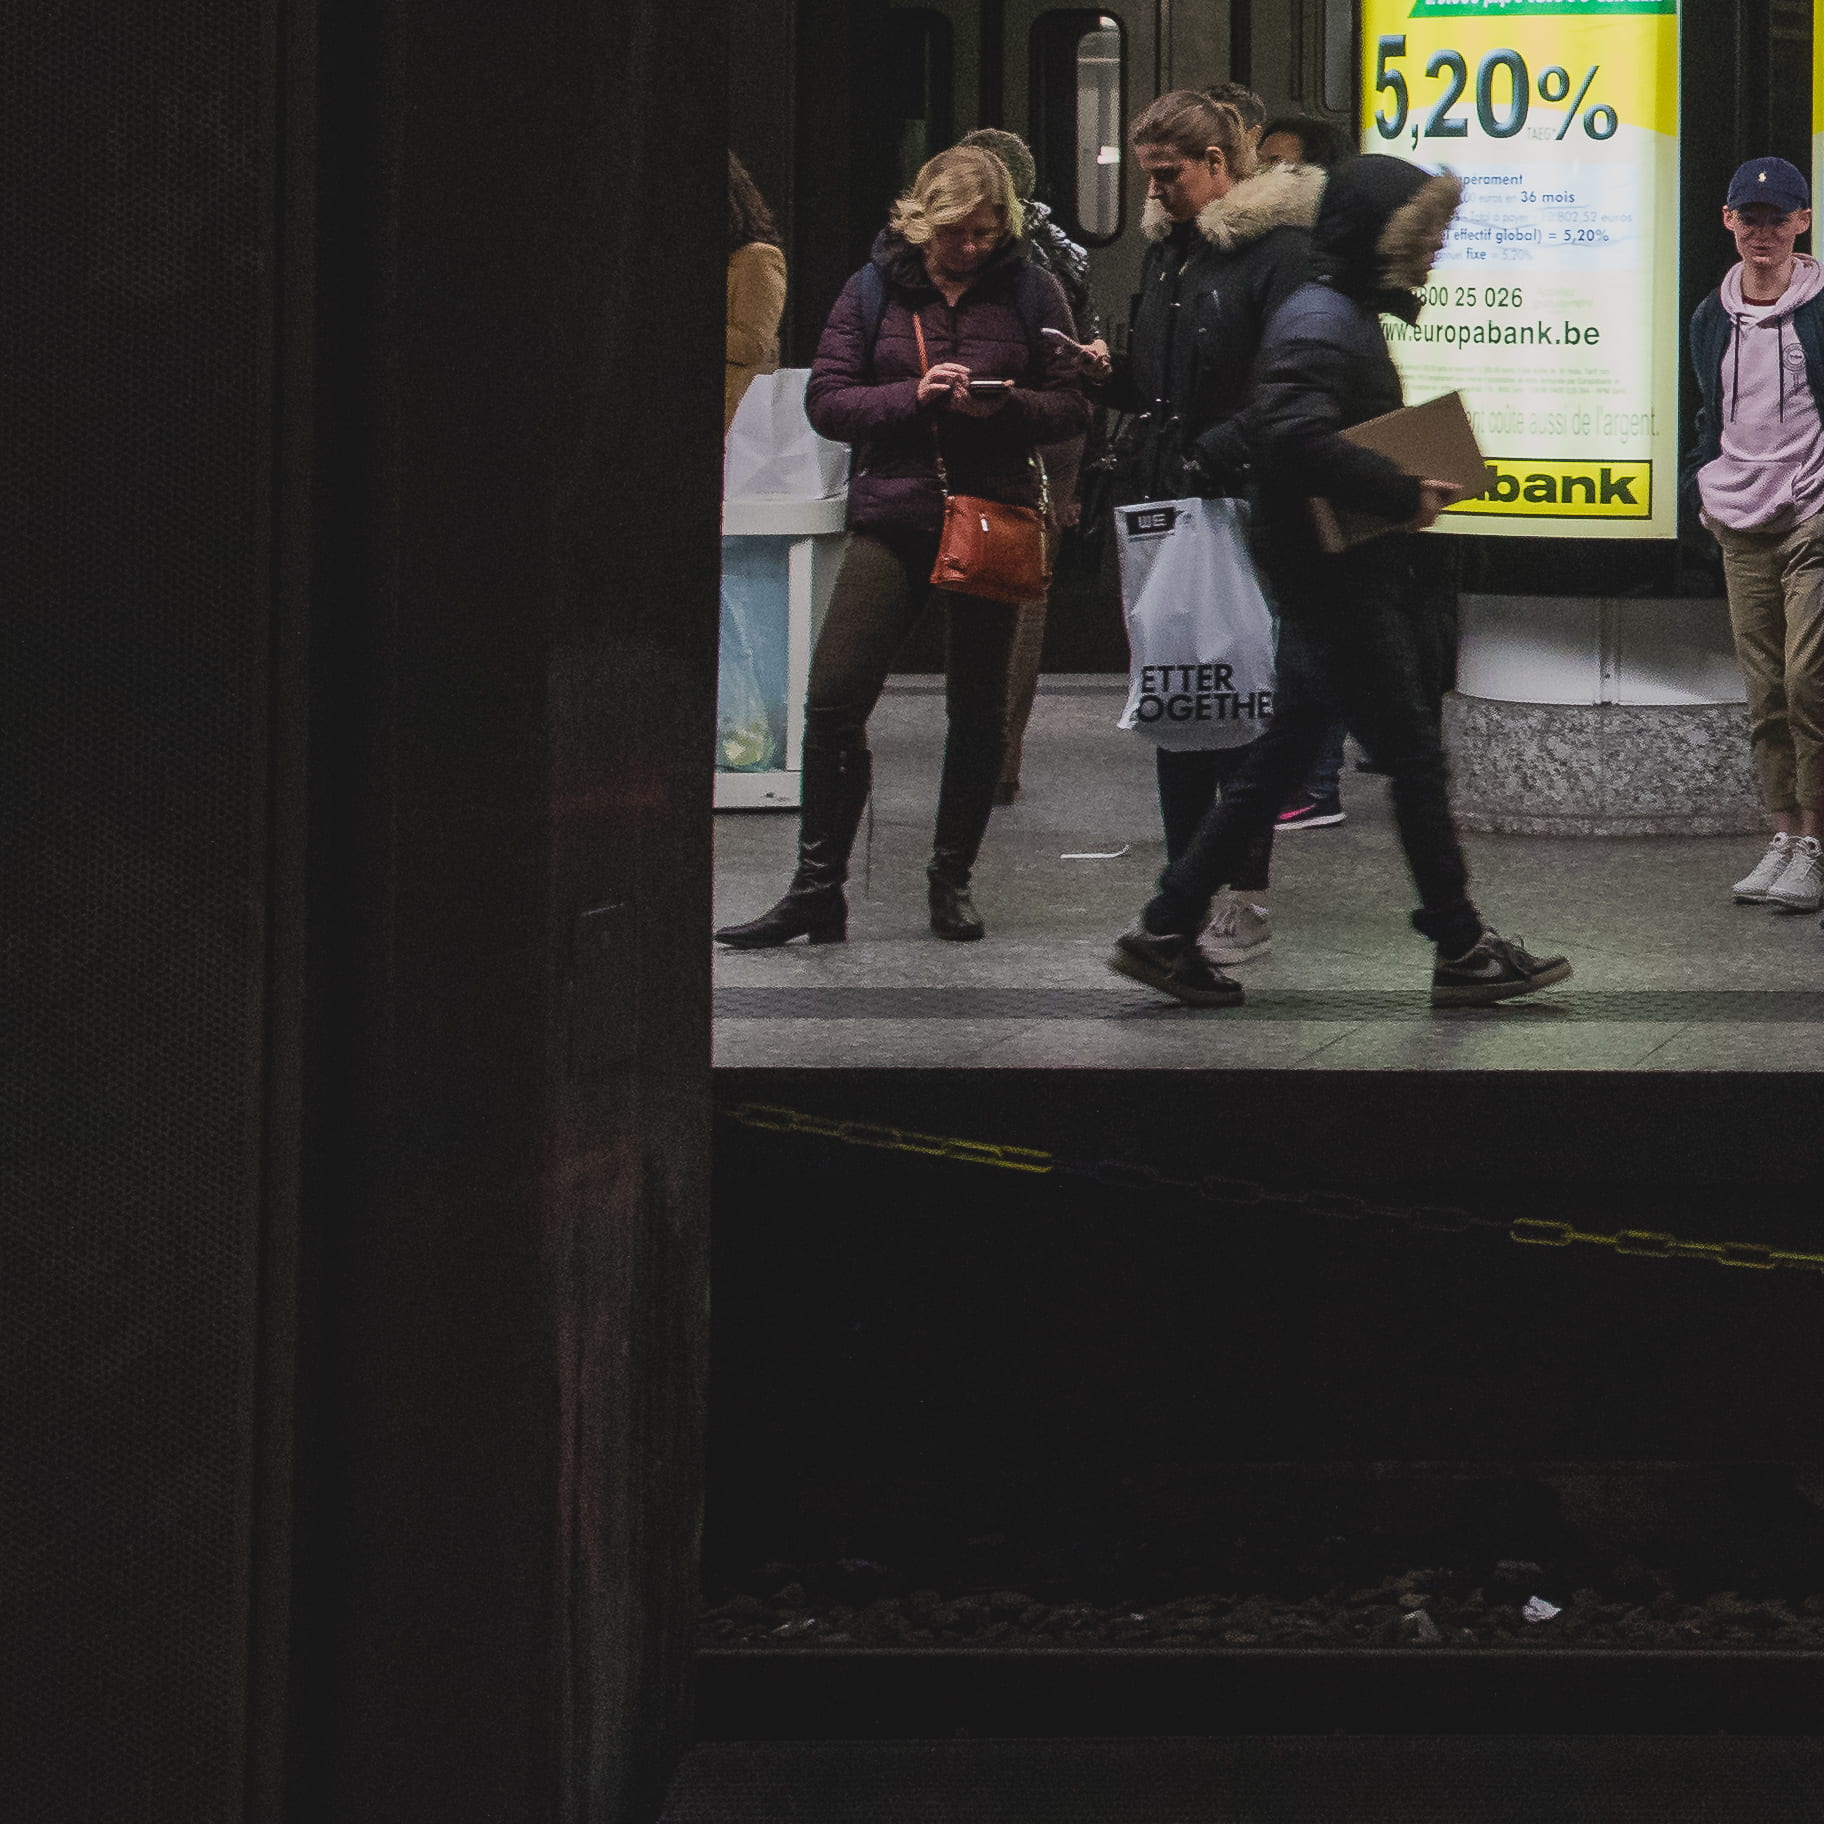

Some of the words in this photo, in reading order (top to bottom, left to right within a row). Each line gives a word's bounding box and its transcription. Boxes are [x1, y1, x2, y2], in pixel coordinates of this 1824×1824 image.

[1374, 34, 1618, 151] 5,20%
[1520, 190, 1537, 203] 36
[1541, 190, 1576, 203] mois
[1454, 227, 1491, 241] effectif
[1495, 227, 1542, 244] global)
[1563, 229, 1610, 244] 5,20%
[1466, 248, 1487, 261] fixe
[1411, 286, 1448, 307] 800
[1455, 287, 1477, 307] 25
[1484, 287, 1523, 307] 026
[1571, 407, 1590, 436] de
[1476, 465, 1639, 505] bank
